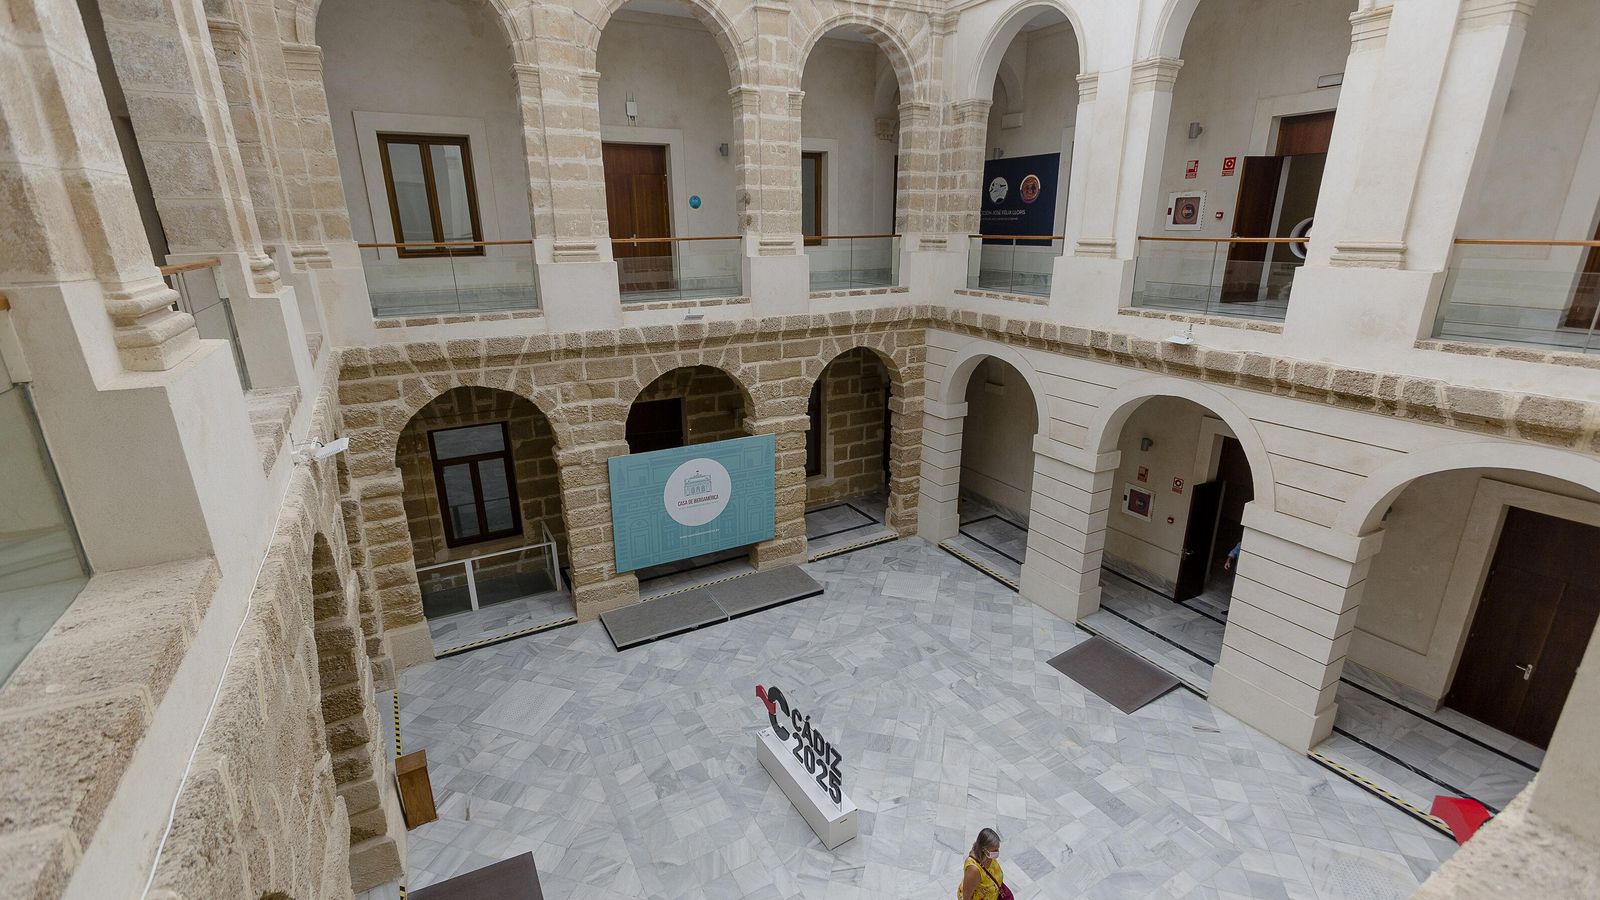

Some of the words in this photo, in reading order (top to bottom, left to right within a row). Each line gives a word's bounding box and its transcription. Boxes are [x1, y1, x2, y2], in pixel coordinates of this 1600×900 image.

[694, 494, 719, 504] IBEROAMÉRICA
[791, 708, 842, 778] CÁDIZ
[792, 732, 842, 804] 2025
